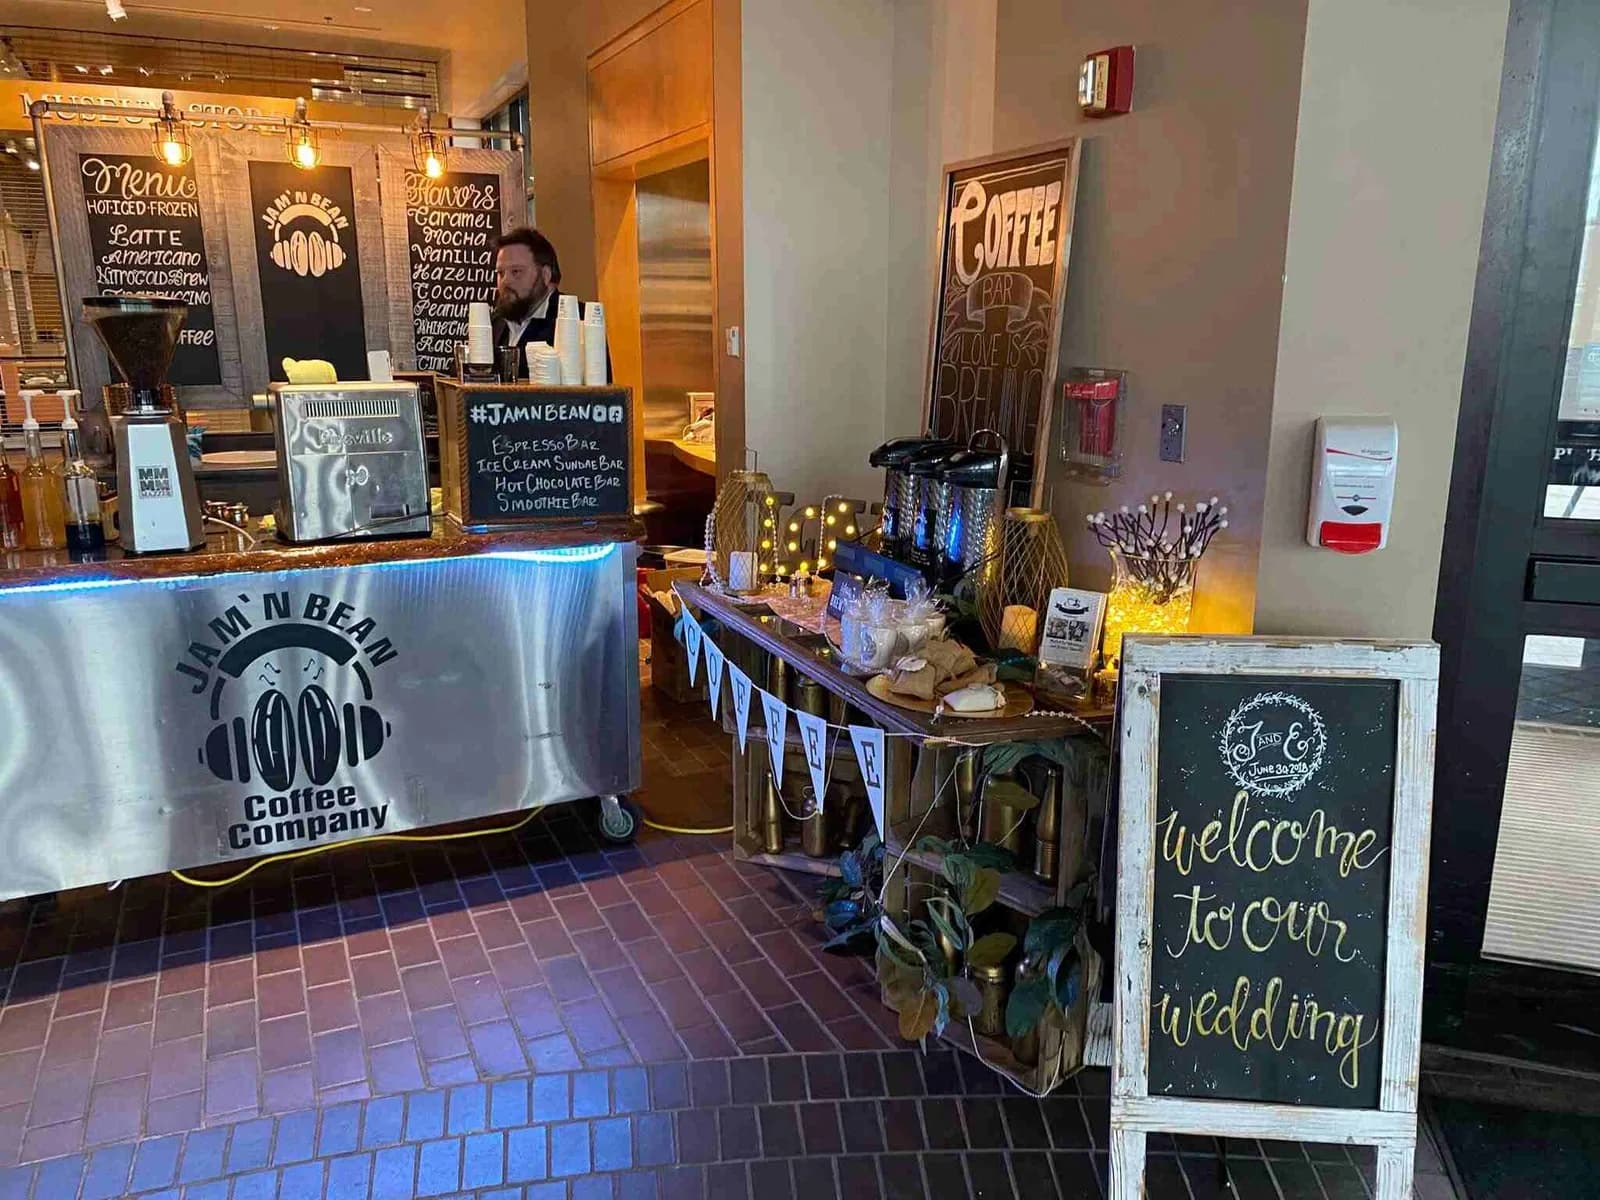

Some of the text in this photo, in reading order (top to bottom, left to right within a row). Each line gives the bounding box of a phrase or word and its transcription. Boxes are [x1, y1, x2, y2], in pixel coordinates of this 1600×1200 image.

[1096, 60, 1105, 102] FIRE
[82, 158, 197, 200] Menu
[405, 171, 500, 210] Flavors
[310, 192, 349, 230] BEAN
[950, 180, 1062, 286] COFFEE
[982, 275, 1014, 307] BAR
[960, 332, 1021, 368] LOVE IS
[470, 403, 591, 426] #JAMNBEAN
[492, 433, 600, 456] ESPRESSO BAR
[476, 454, 625, 474] ICE CREAM SUNDAE BAR
[495, 474, 621, 494] HOT CHOCOLATE BAR
[496, 492, 600, 512] SMOOTHIE BAR
[302, 592, 399, 668] BEAN
[243, 785, 357, 822] Coffee
[228, 804, 389, 851] Company
[1155, 790, 1390, 878] welcome
[1166, 885, 1358, 963] to our
[1152, 976, 1380, 1089] wedding
